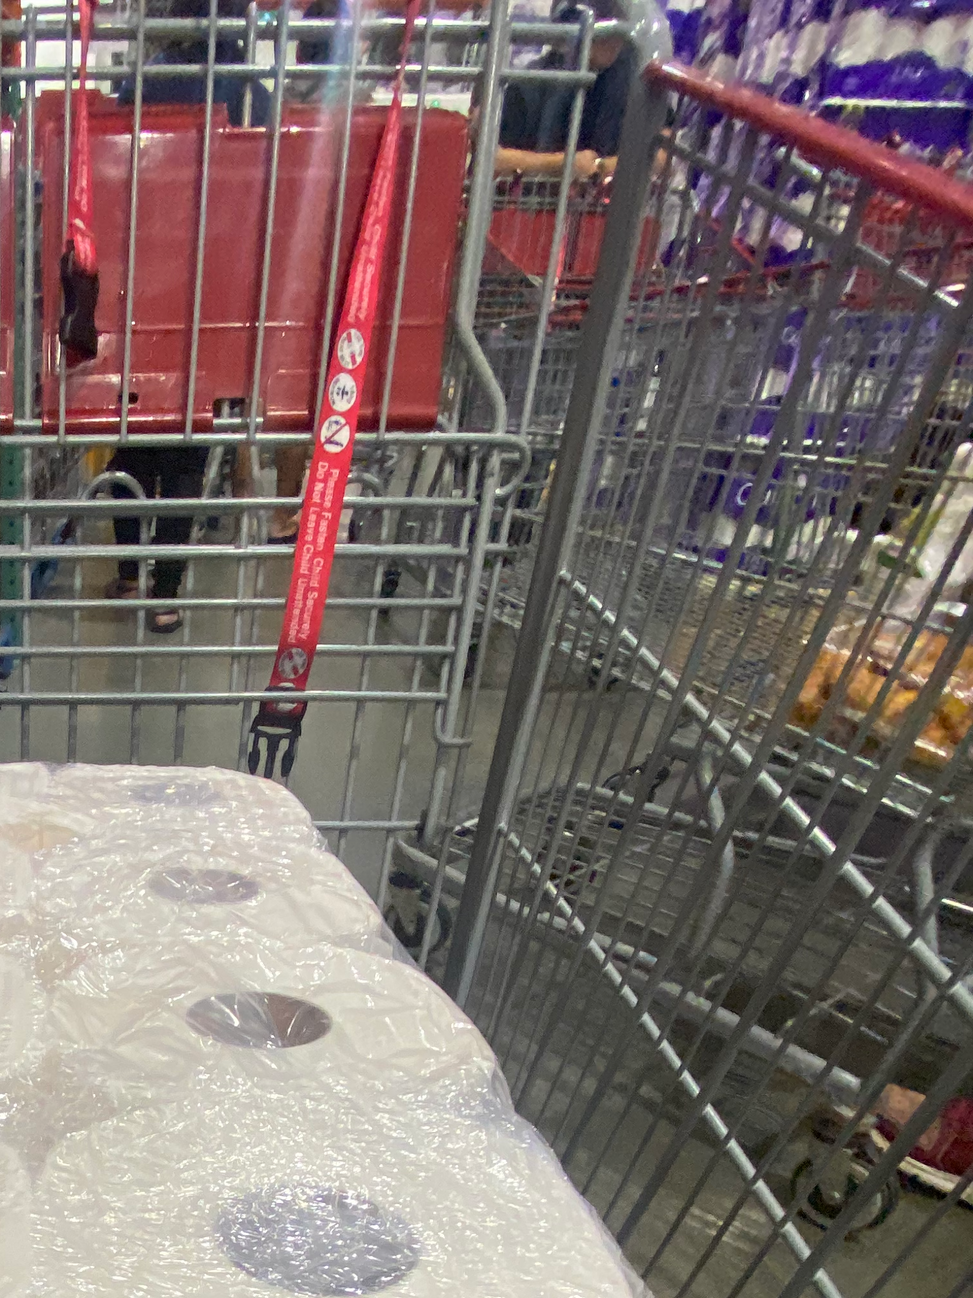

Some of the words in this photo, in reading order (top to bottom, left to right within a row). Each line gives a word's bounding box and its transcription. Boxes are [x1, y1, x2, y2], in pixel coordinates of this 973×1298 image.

[316, 461, 329, 480] Do
[312, 482, 325, 503] Not
[323, 468, 340, 509] Please
[304, 506, 320, 542] Leave
[316, 512, 332, 551] Fasten
[299, 544, 314, 575] Child
[309, 557, 325, 588] Child
